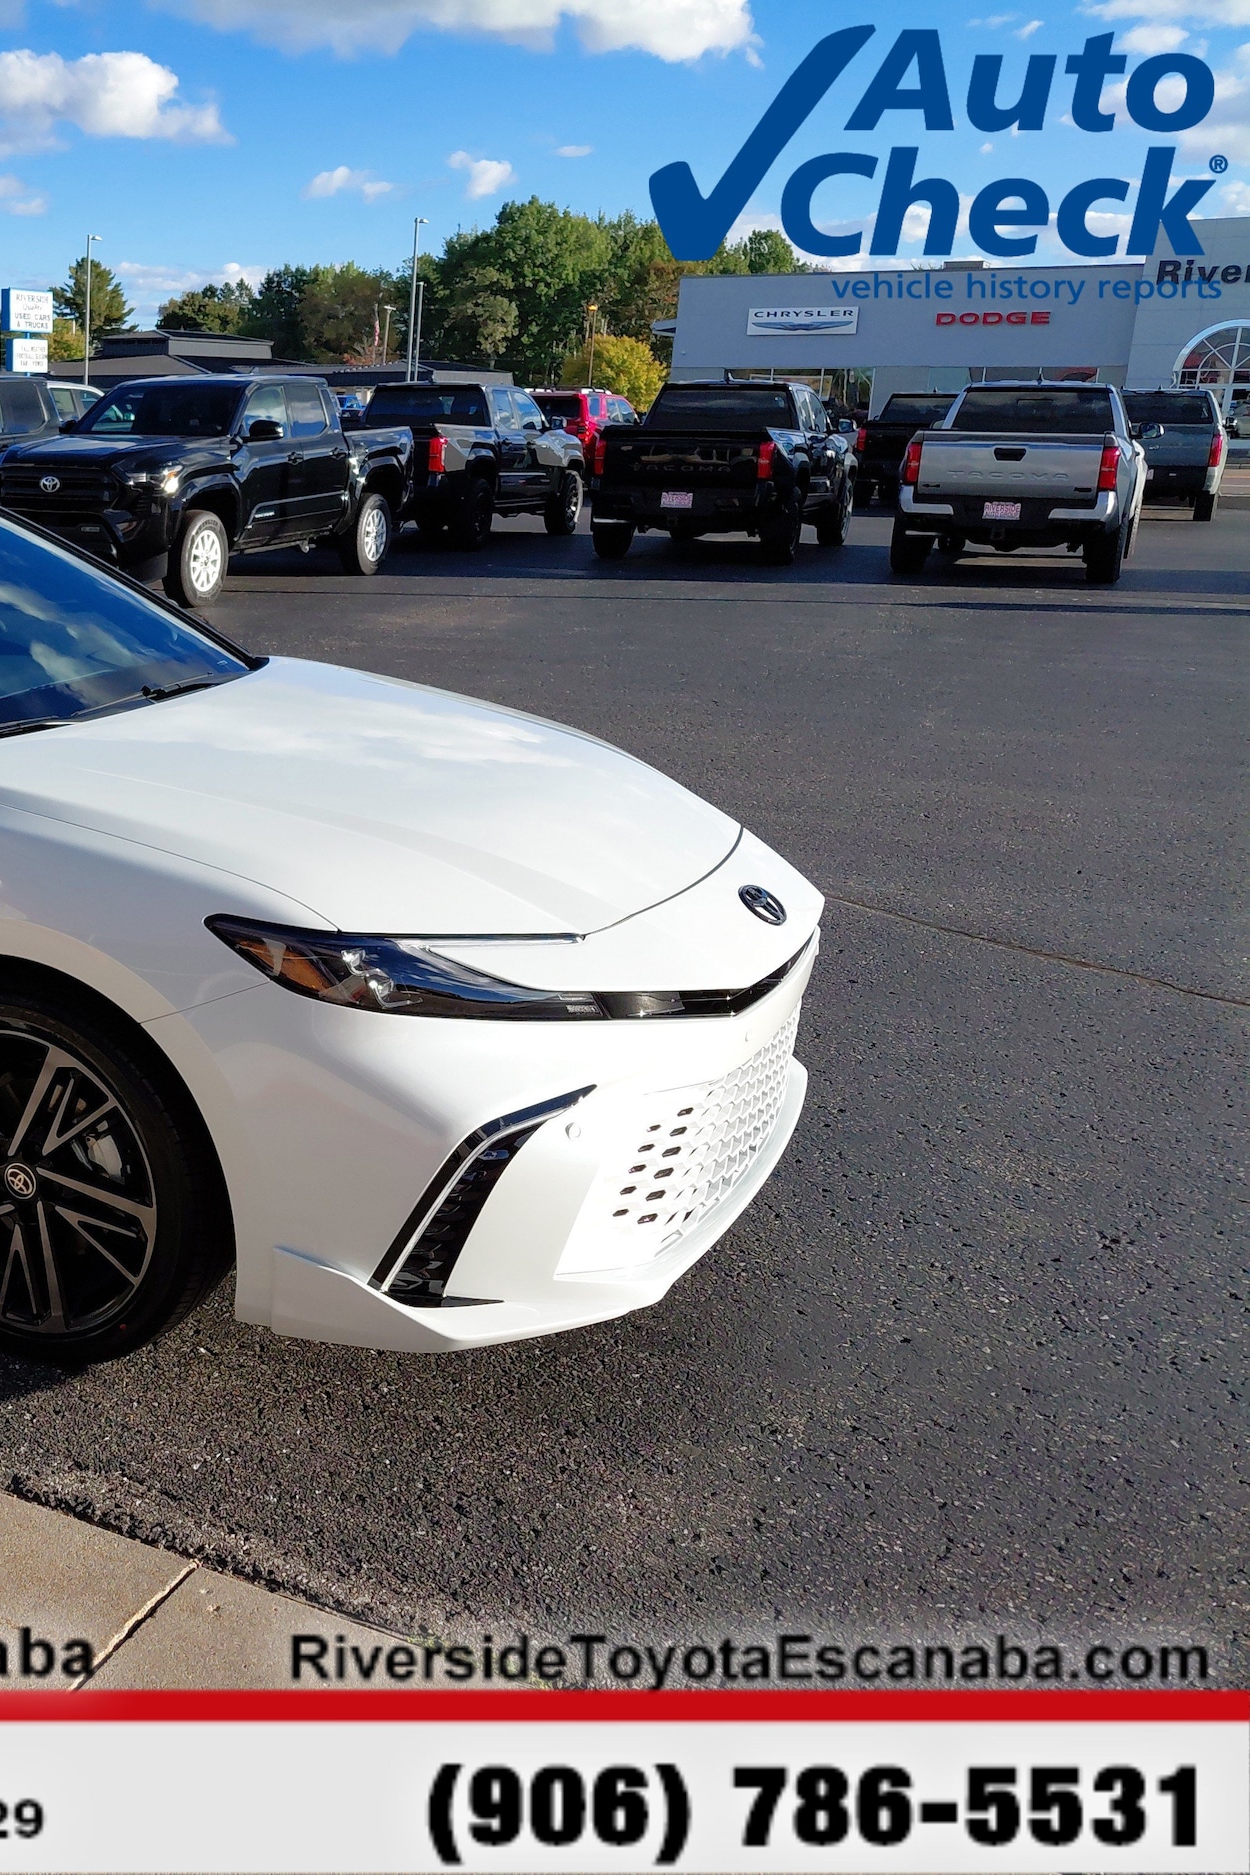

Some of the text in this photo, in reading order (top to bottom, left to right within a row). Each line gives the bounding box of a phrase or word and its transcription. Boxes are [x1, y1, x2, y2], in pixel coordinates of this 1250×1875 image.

[754, 309, 853, 319] CHRYSLER
[936, 311, 1051, 326] DODGE
[947, 470, 1069, 482] TACOMA
